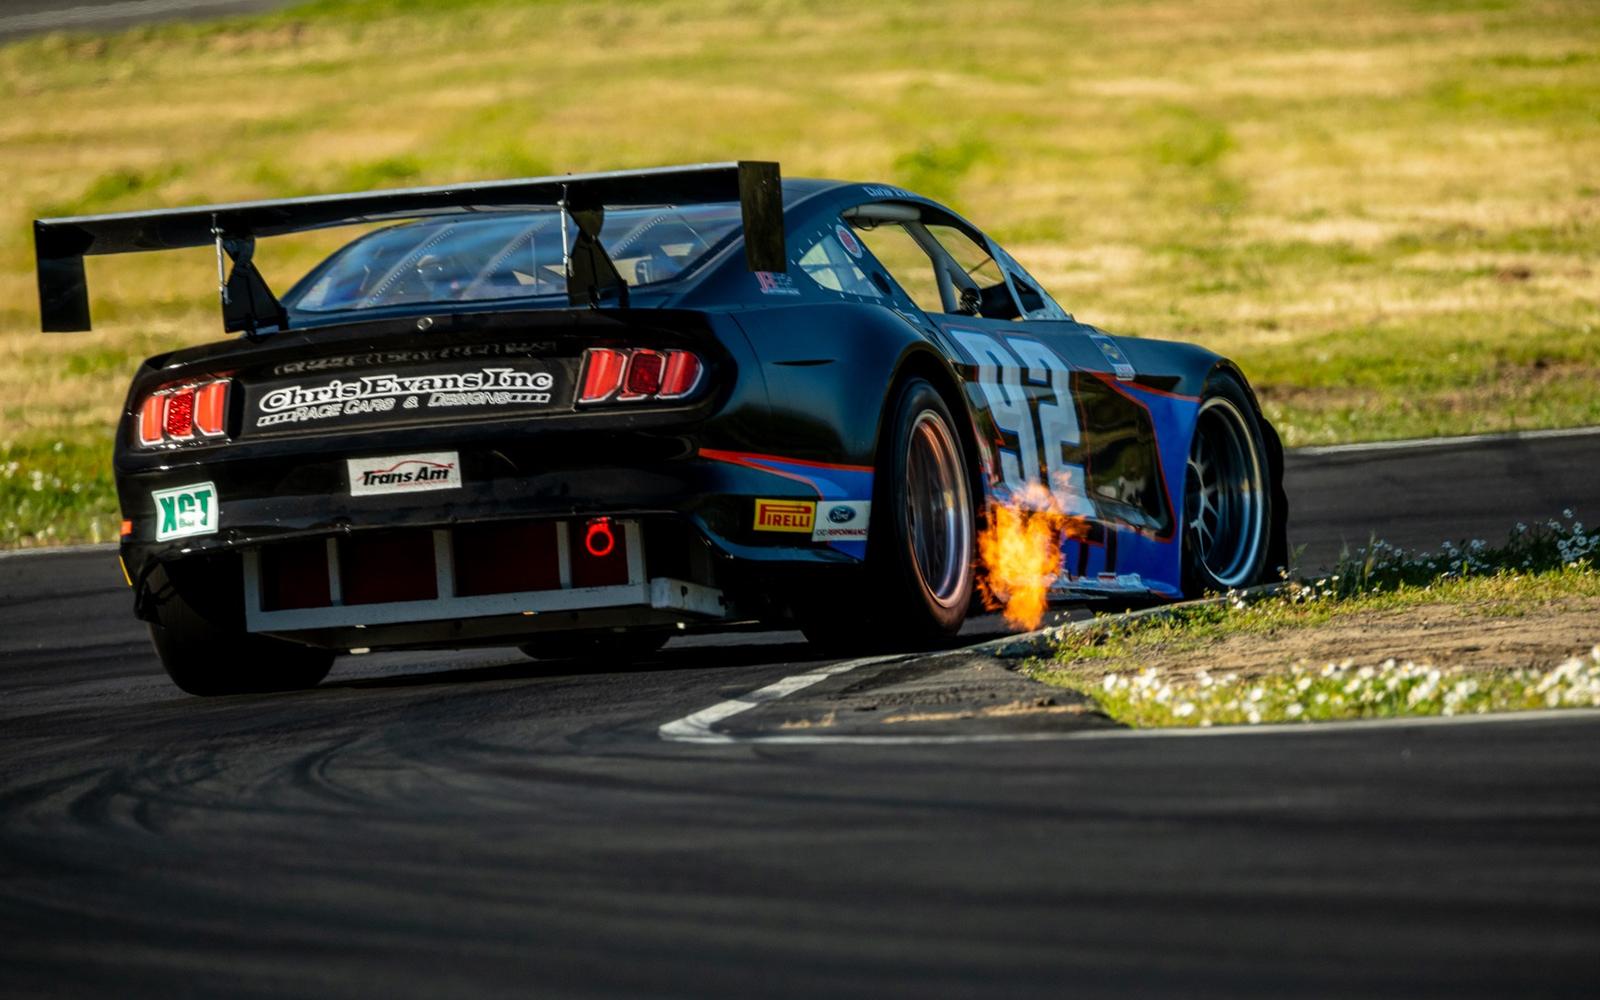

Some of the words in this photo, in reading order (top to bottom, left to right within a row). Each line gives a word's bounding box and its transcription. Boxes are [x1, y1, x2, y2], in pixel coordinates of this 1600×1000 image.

[294, 403, 343, 422] RACE
[343, 397, 396, 415] CARS
[402, 395, 419, 409] &
[951, 329, 1098, 518] 92
[363, 471, 413, 486] Trans
[415, 466, 449, 482] Am
[758, 503, 812, 529] PIRELLI
